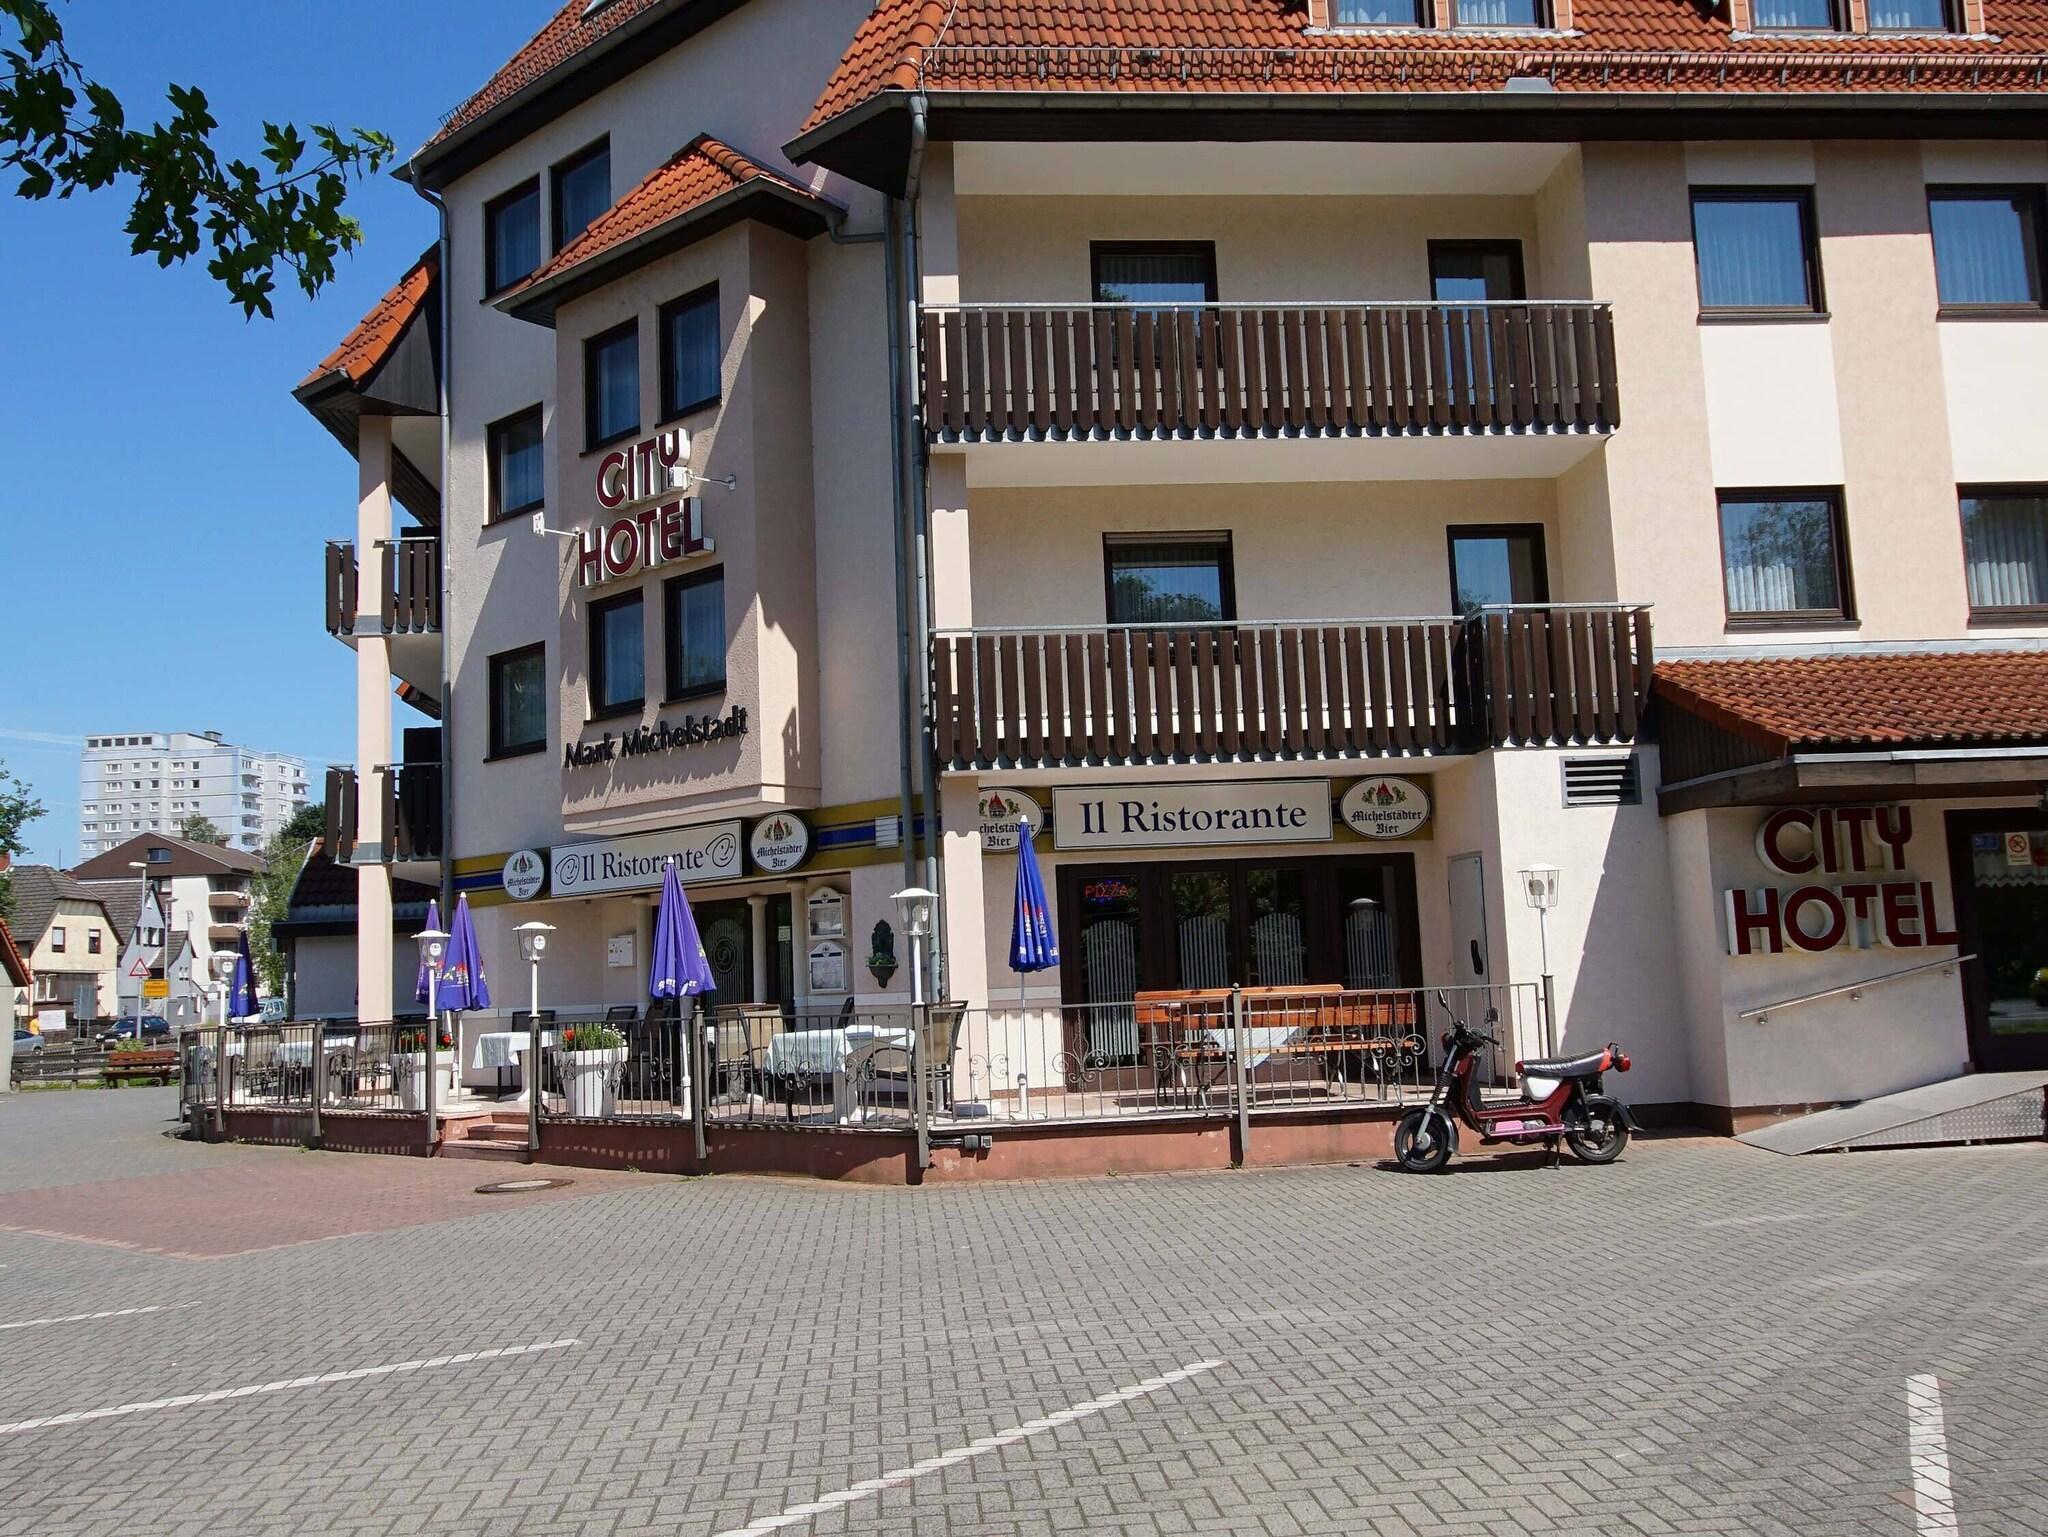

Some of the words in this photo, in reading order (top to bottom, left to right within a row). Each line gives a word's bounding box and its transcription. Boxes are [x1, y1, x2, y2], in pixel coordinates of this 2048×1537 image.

[596, 428, 688, 509] CITY
[578, 497, 711, 588] HOTEL
[621, 704, 748, 757] Michelstadt
[565, 732, 616, 768] Mark
[1079, 800, 1108, 834] Il
[1118, 800, 1308, 833] Ristorante
[1375, 823, 1399, 834] Bier
[987, 836, 1012, 847] Bier
[1757, 806, 1912, 875] CITY
[582, 854, 595, 882] Il
[602, 848, 704, 880] Ristorante
[771, 858, 787, 868] Bier
[1726, 881, 1958, 955] HOTEL
